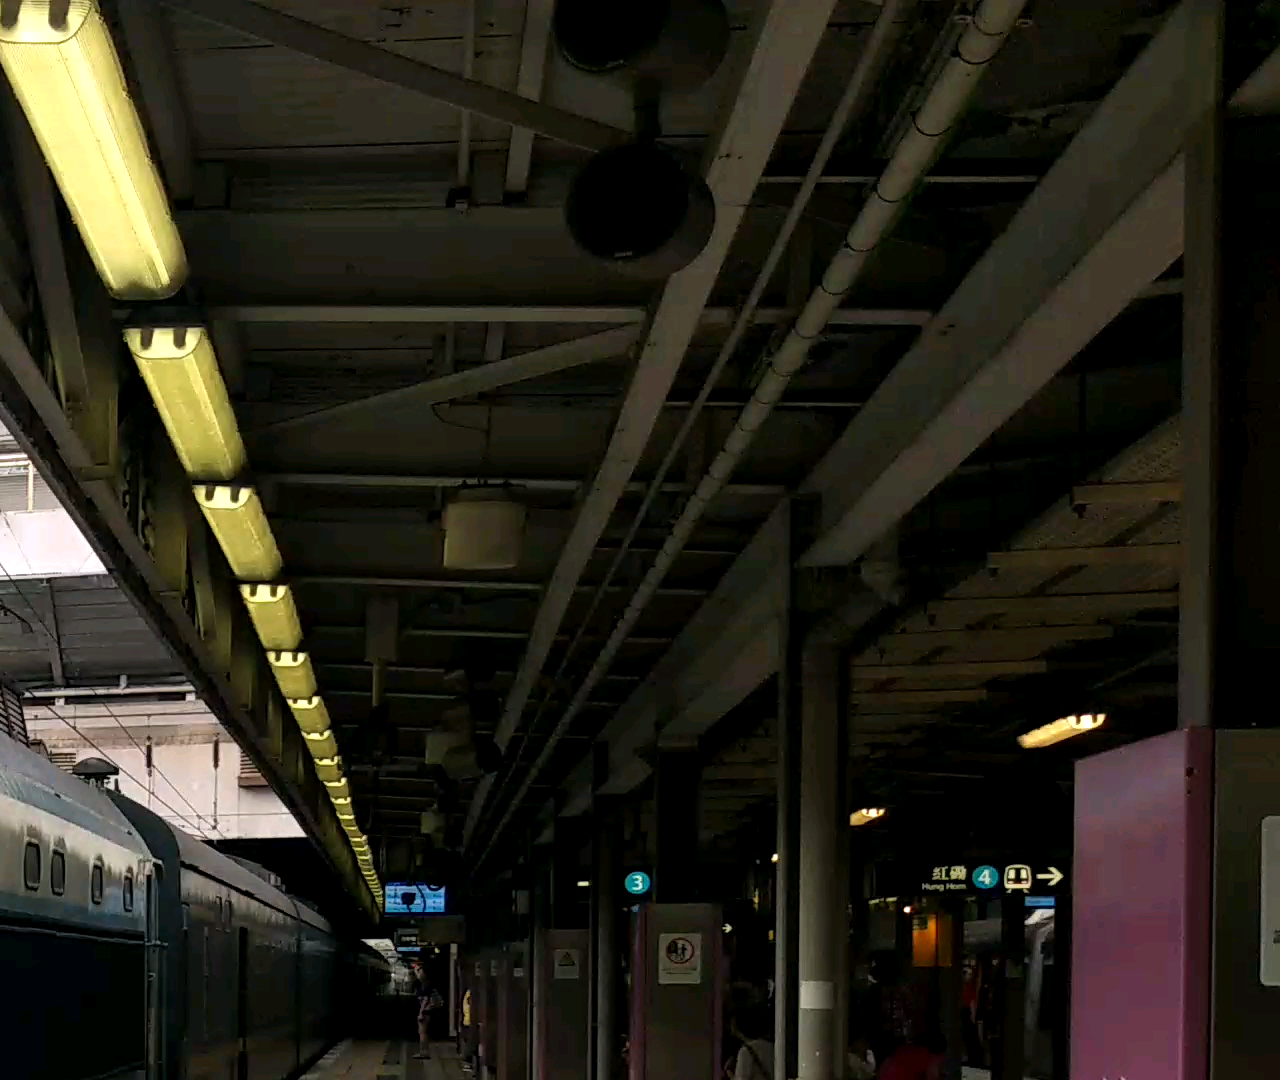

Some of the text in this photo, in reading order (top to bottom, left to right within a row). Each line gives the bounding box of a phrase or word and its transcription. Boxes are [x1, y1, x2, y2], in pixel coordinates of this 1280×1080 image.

[632, 876, 643, 890] 3
[979, 869, 991, 884] 4
[922, 883, 944, 891] Hung
